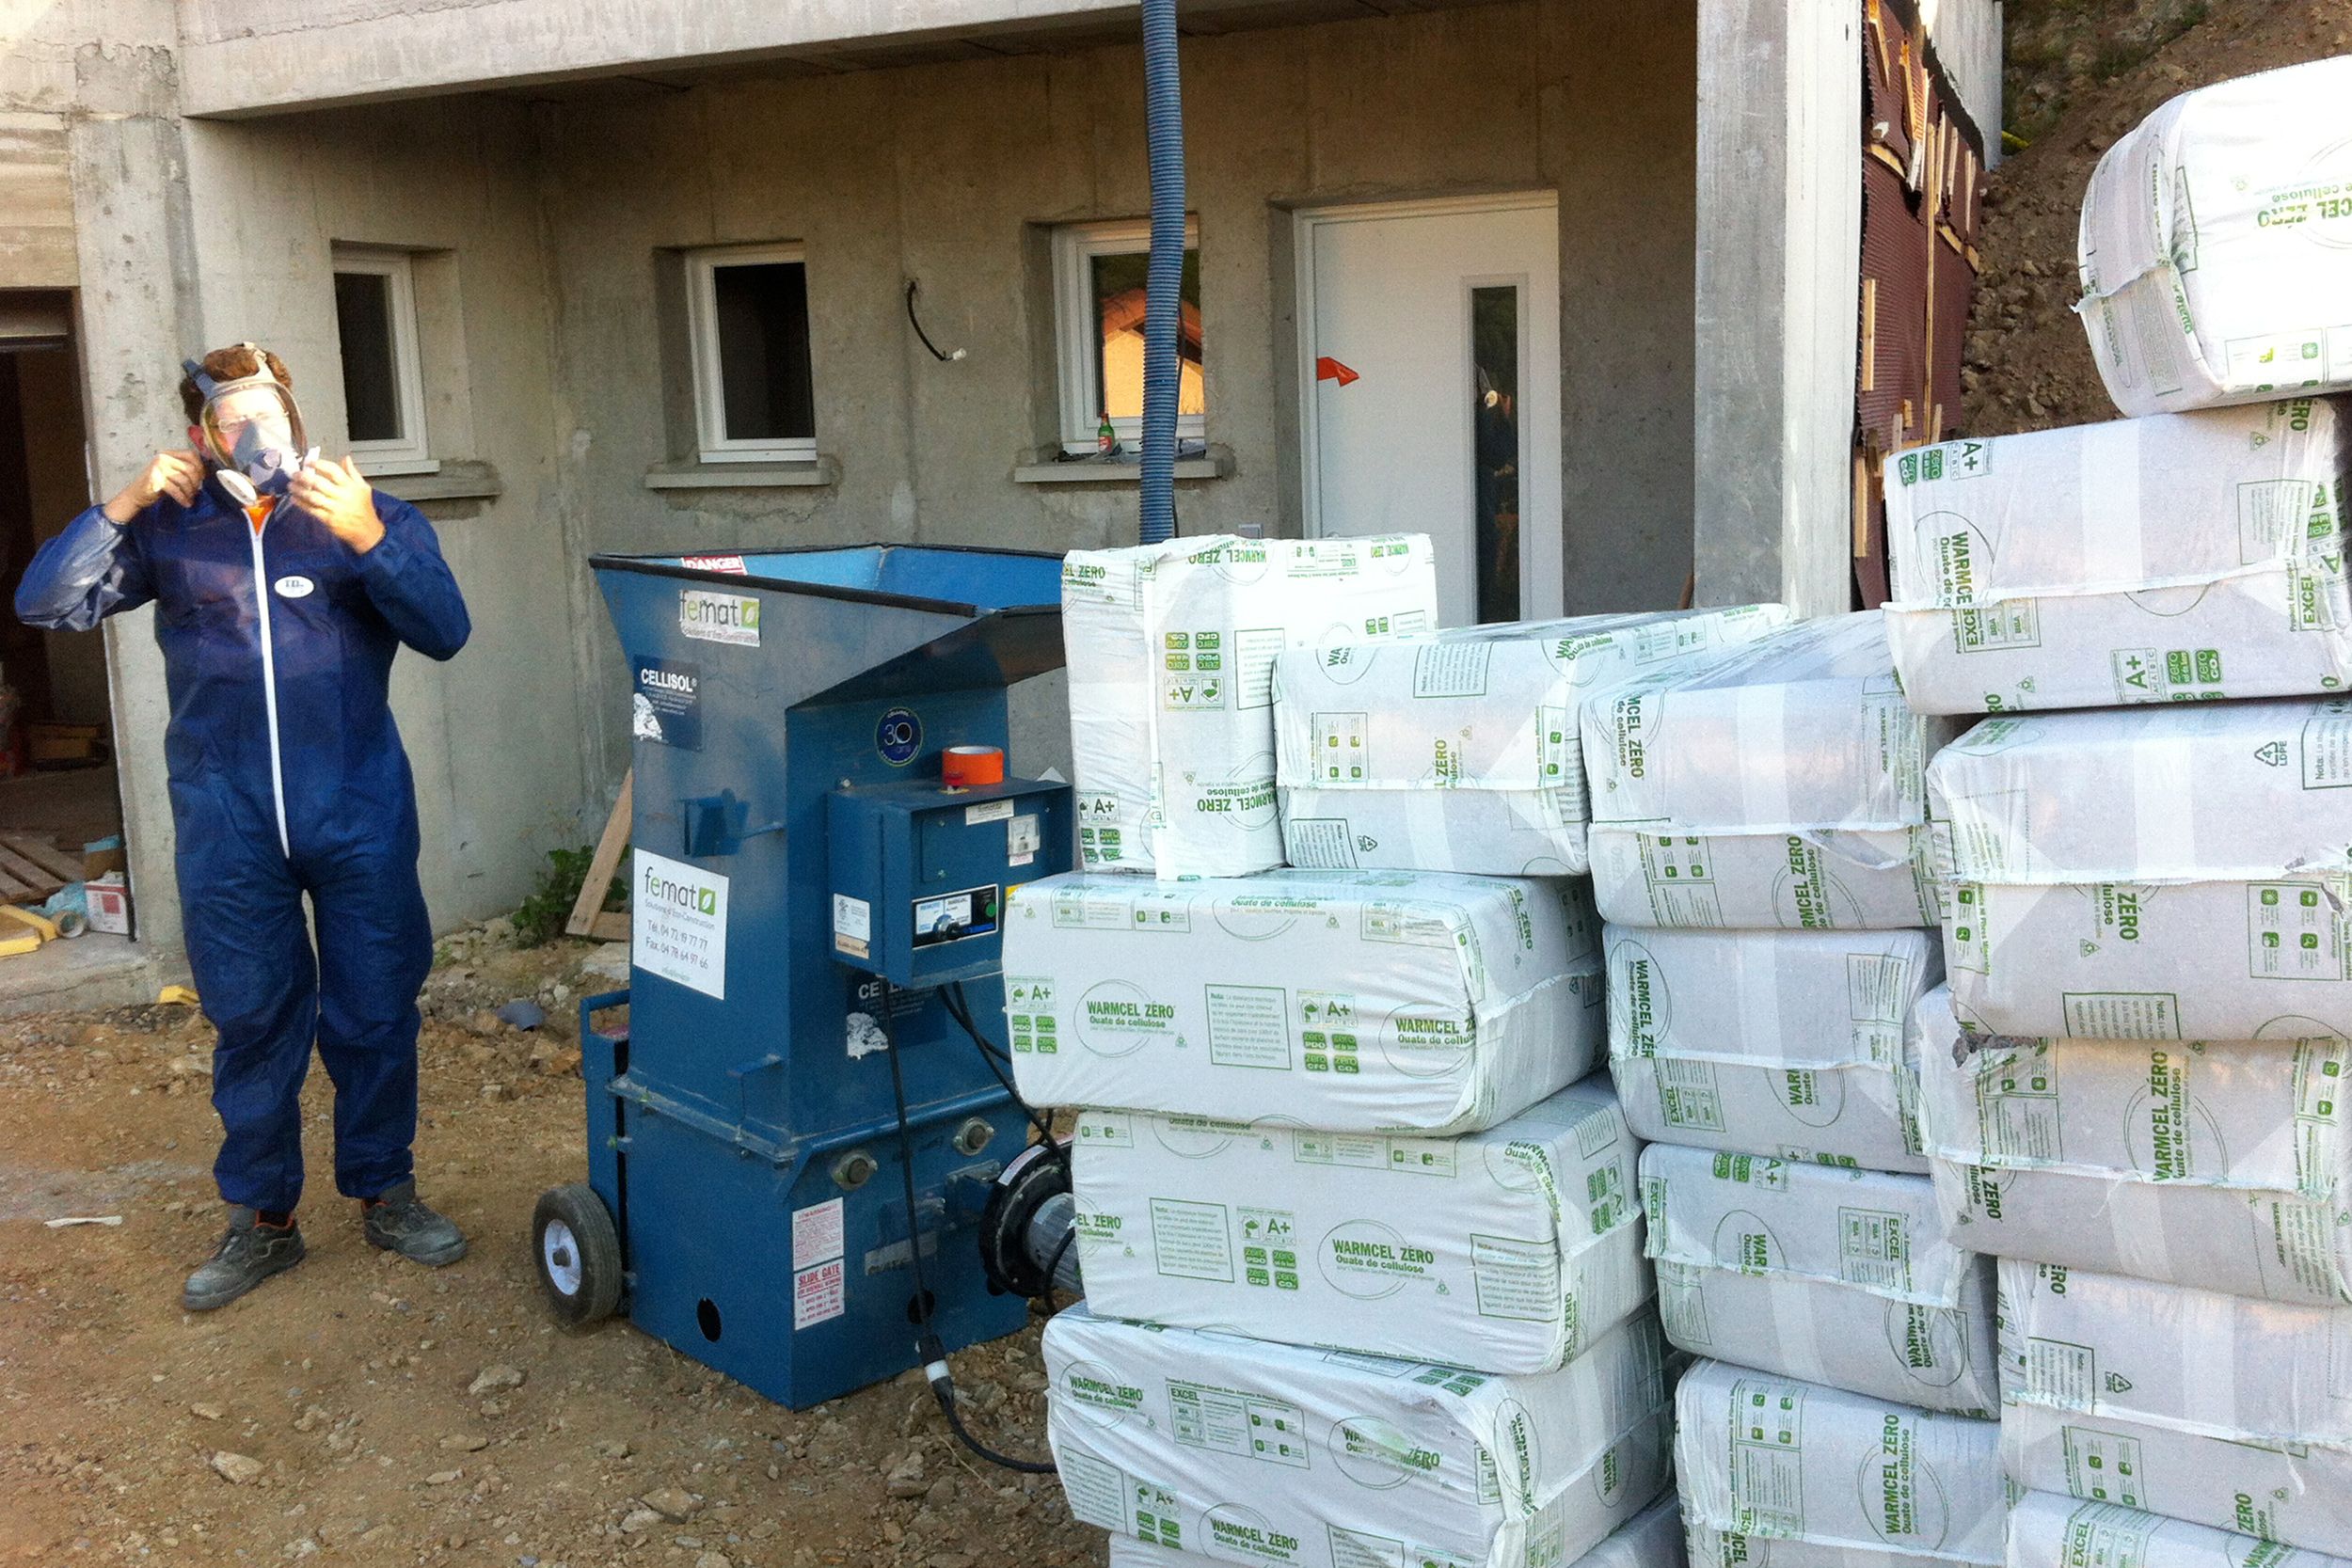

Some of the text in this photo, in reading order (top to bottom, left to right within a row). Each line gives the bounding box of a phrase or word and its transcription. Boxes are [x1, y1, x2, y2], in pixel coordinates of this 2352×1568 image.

[2272, 184, 2340, 203] cellulose
[1931, 449, 1942, 480] zero
[1962, 441, 1982, 470] A+
[687, 556, 741, 571] DANGER
[1226, 548, 1267, 563] WARMCEL
[1940, 537, 1952, 596] Ouate de
[1952, 531, 1973, 605] WARMCE
[680, 590, 739, 626] femat
[2302, 573, 2315, 624] EXCEL
[1963, 608, 1979, 646] EXCE
[2125, 656, 2148, 689] A+
[2169, 653, 2180, 683] zero
[2197, 651, 2209, 682] zero
[1169, 686, 1194, 703] A+
[1627, 695, 1641, 735] MCEL
[884, 721, 912, 746] 30
[1616, 717, 1627, 767] cellulose
[2279, 740, 2288, 767] LDPE
[1094, 799, 1114, 814] A+
[644, 866, 697, 910] femat
[1806, 848, 1821, 899] cellulose
[1794, 882, 1816, 928] RMCEL
[1814, 902, 1824, 914] de
[2118, 893, 2141, 941] ZÉRO
[1032, 985, 1052, 1001] A+
[1087, 1001, 1141, 1018] WARMCEL
[1089, 1016, 1166, 1029] Ouate de cellulose
[1327, 1001, 1351, 1018] A+
[1635, 959, 1656, 1058] WARMCEL ZÉR
[1395, 1018, 1460, 1035] WARMCEL
[1398, 1034, 1441, 1044] Ouate de
[1804, 1072, 1814, 1105] Ouate
[2149, 1051, 2169, 1099] ZÉRO
[1665, 1086, 1679, 1123] EXCEL
[2170, 1068, 2183, 1146] de cellulose
[1765, 1159, 1782, 1185] A+
[1650, 1181, 1660, 1222] EXCEL
[1982, 1180, 2002, 1220] ZÉRO
[1267, 1218, 1291, 1235] A+
[1889, 1218, 1899, 1261] EXCEL
[1246, 1257, 1266, 1265] PDO
[1332, 1239, 1395, 1259] WARMCEL
[1743, 1233, 1752, 1266] Ouate
[798, 1263, 840, 1286] SLIDE GATE
[1336, 1255, 1424, 1274] Ouate de cellulose
[1069, 1375, 1116, 1396] WARMCEL
[1170, 1387, 1200, 1402] EXCEL
[1899, 1429, 1912, 1534] Ouate de cellulose
[1155, 1491, 1174, 1506] A+
[1883, 1462, 1900, 1534] WARMCEL
[1211, 1518, 1263, 1543] WARMCEL
[2072, 1521, 2090, 1567] EXCEL
[1240, 1538, 1252, 1549] de
[1252, 1541, 1291, 1559] cellulose
